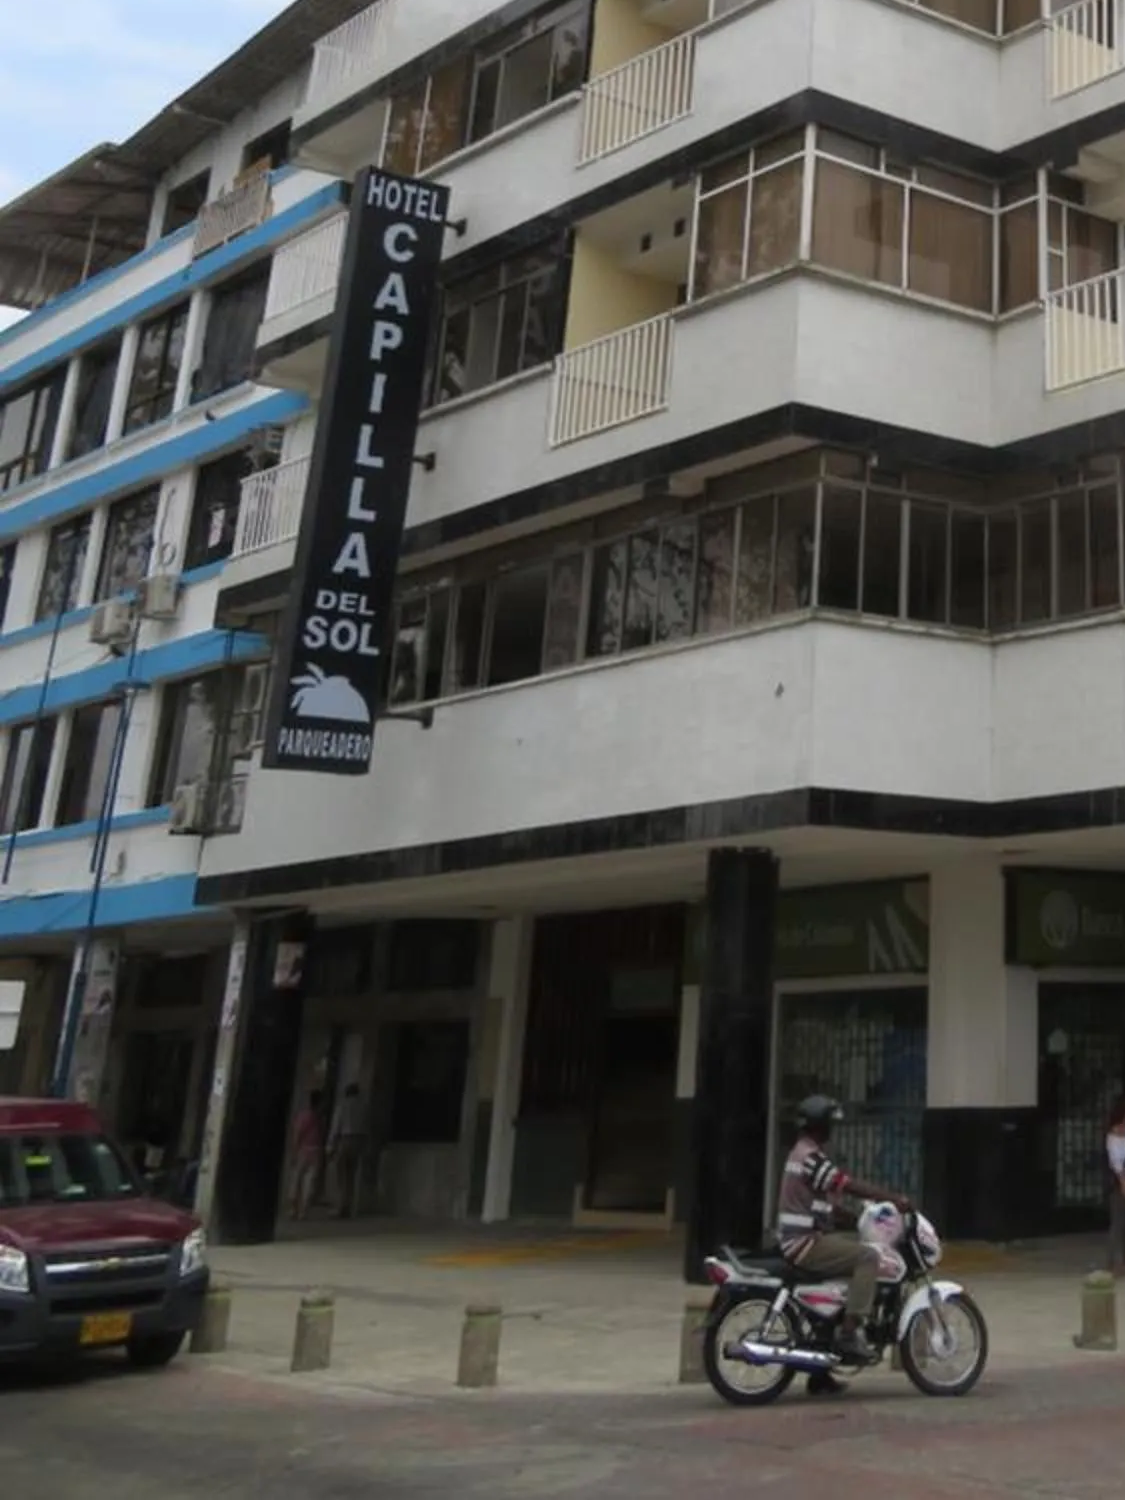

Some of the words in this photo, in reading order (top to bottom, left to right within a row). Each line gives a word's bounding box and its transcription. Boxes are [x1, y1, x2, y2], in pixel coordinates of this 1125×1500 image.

[367, 174, 442, 222] HOTEL
[333, 222, 418, 577] CAPILLA
[315, 589, 375, 616] DEL
[303, 615, 380, 656] SOL
[277, 727, 371, 760] PARQUEADERO
